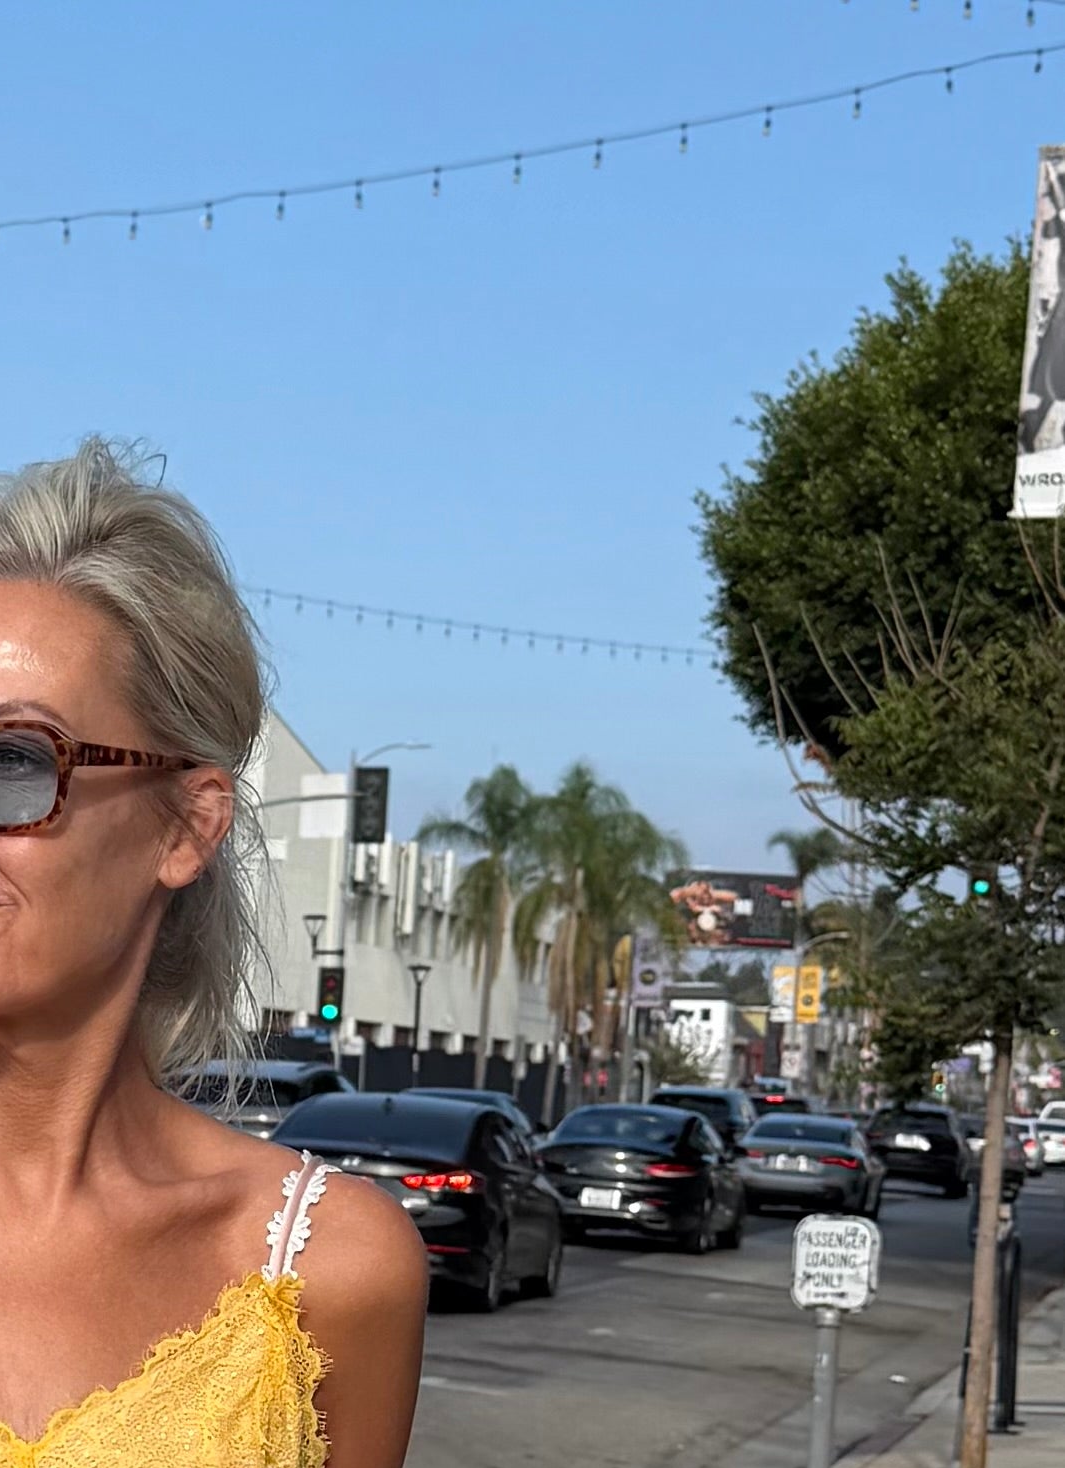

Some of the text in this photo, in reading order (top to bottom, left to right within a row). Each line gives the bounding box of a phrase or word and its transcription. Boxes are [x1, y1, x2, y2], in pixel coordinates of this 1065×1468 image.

[799, 1231, 867, 1249] PASSENGER
[806, 1252, 857, 1269] LOADING
[813, 1271, 844, 1288] ONLY
